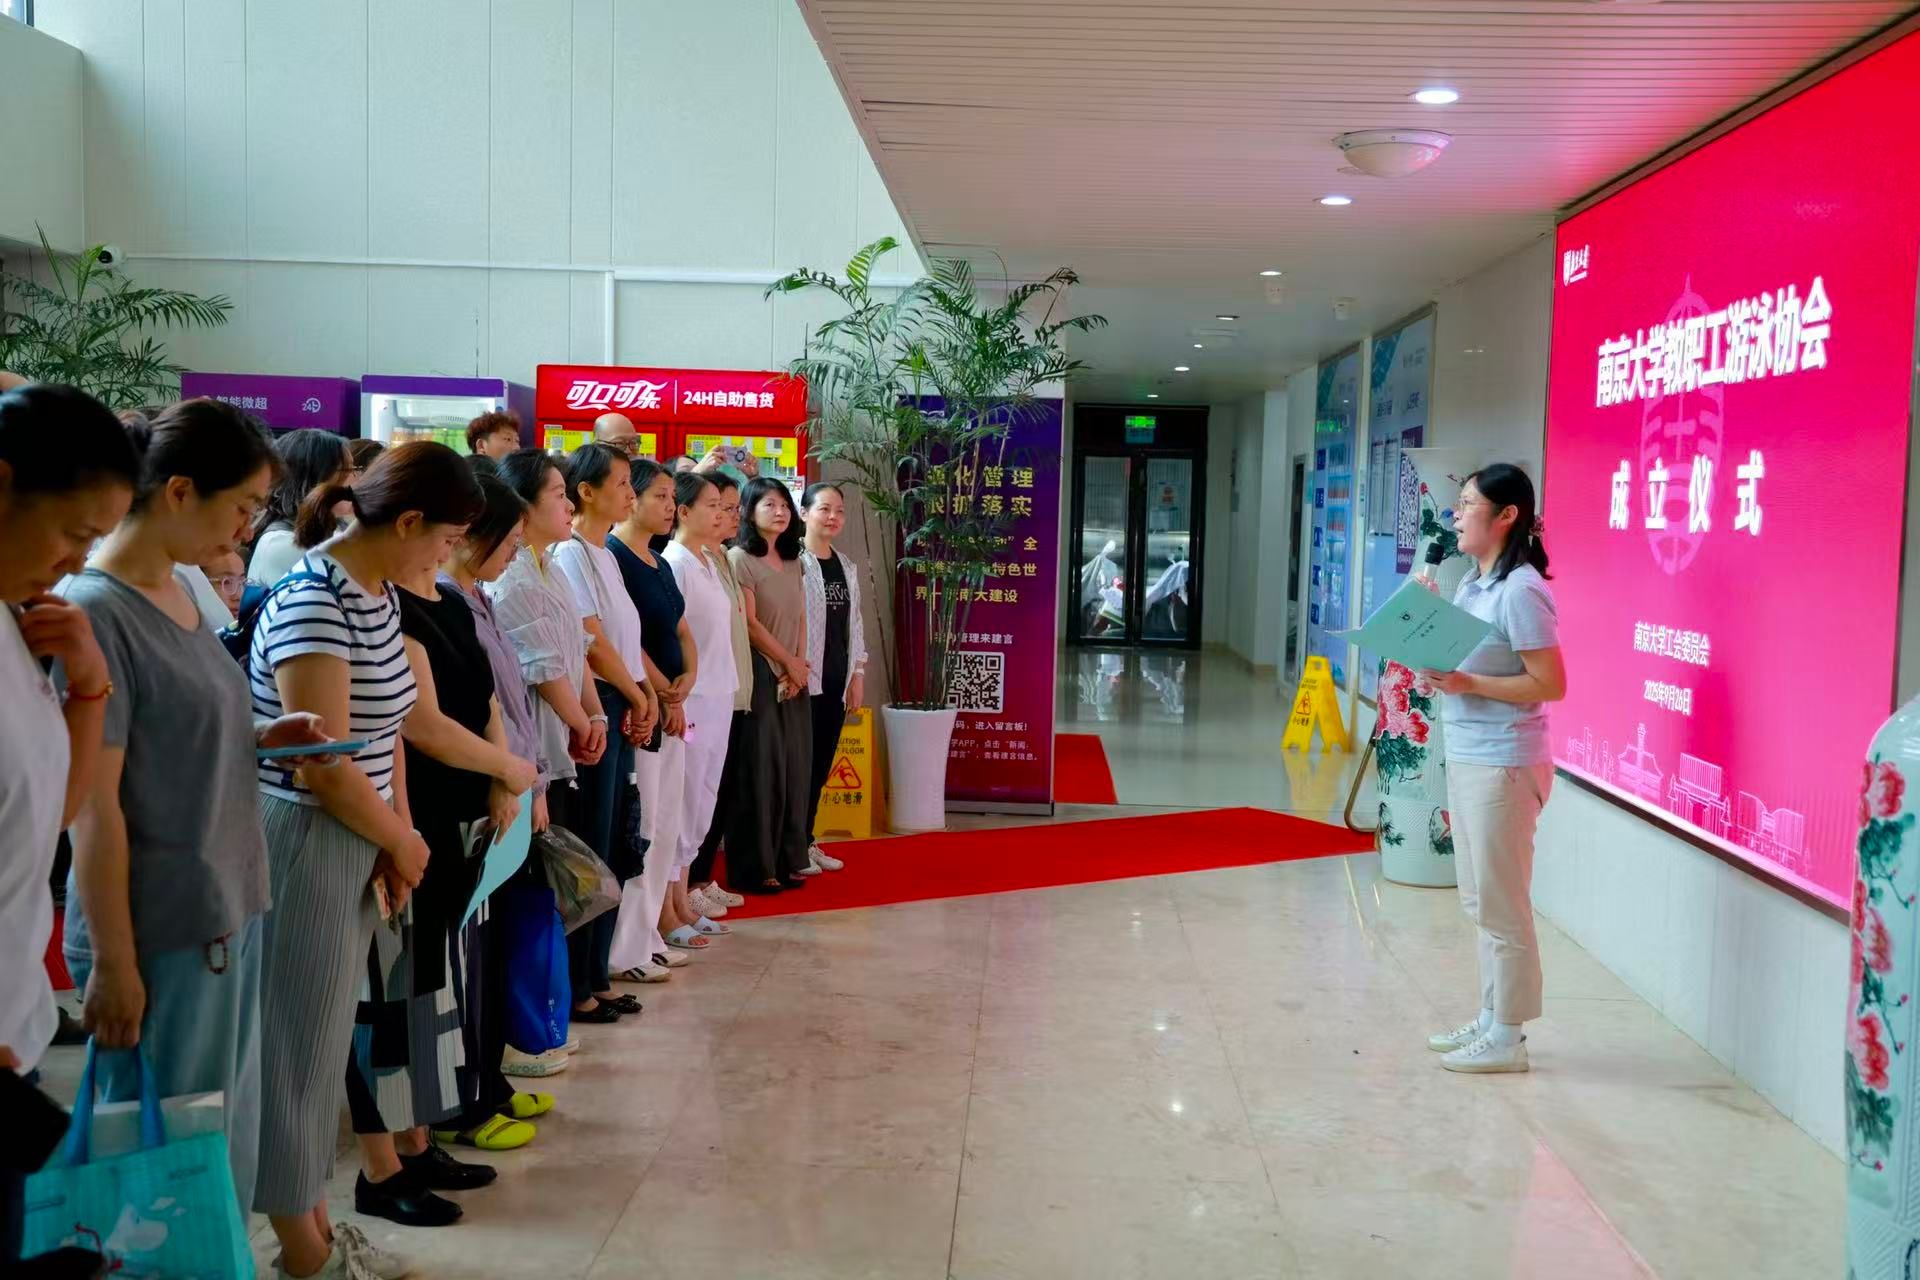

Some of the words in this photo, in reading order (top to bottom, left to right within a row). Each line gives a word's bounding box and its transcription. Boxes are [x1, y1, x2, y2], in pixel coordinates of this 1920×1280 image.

[1596, 275, 1832, 408] 南京大学教职工游泳协会
[566, 379, 668, 410] 可口可乐
[683, 390, 775, 409] 24H自助售货
[1609, 449, 1765, 536] 成立仪式
[915, 586, 1018, 603] 界一南大建设
[1634, 620, 1710, 667] 南京大学工会委员会
[823, 791, 862, 805] 小心地滑
